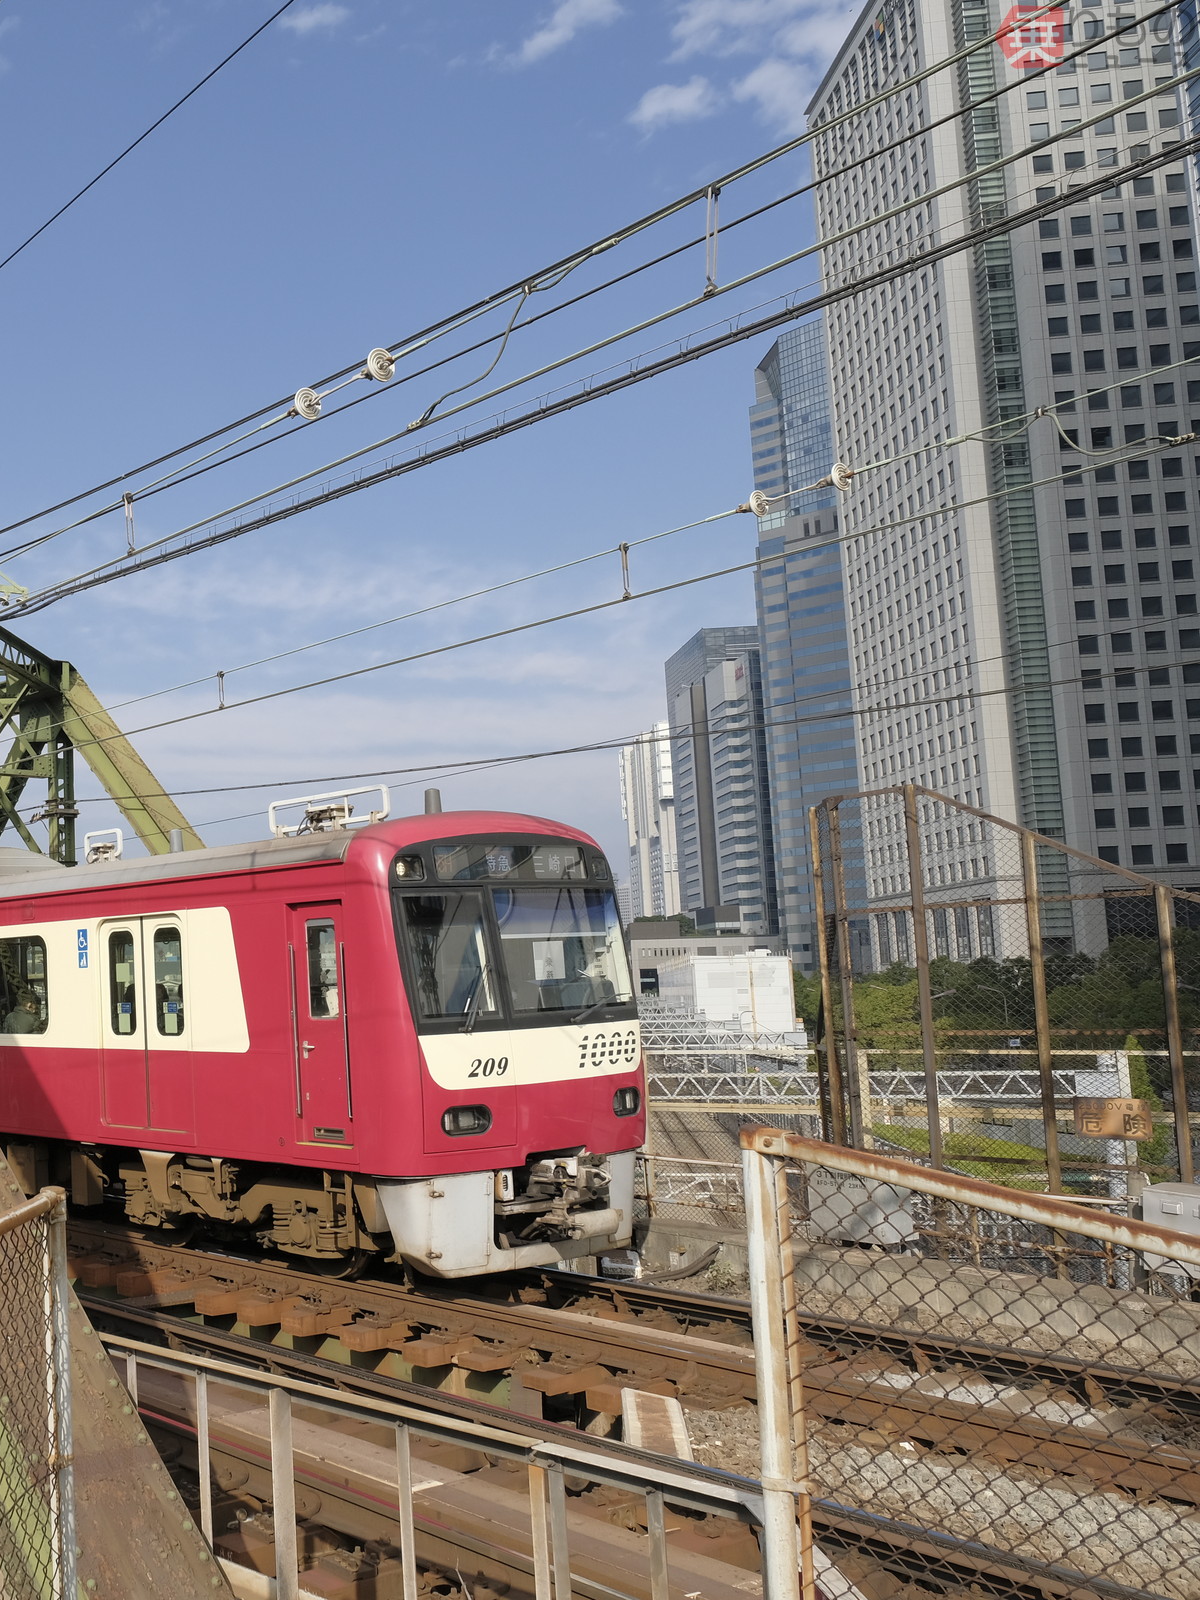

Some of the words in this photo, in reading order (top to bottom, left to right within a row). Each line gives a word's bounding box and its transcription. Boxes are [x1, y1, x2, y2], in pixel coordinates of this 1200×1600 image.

[486, 854, 511, 872] 特急
[533, 854, 576, 873] 三崎口
[579, 1030, 636, 1068] 1000
[468, 1056, 509, 1078] 209
[1080, 1112, 1148, 1136] 危険
